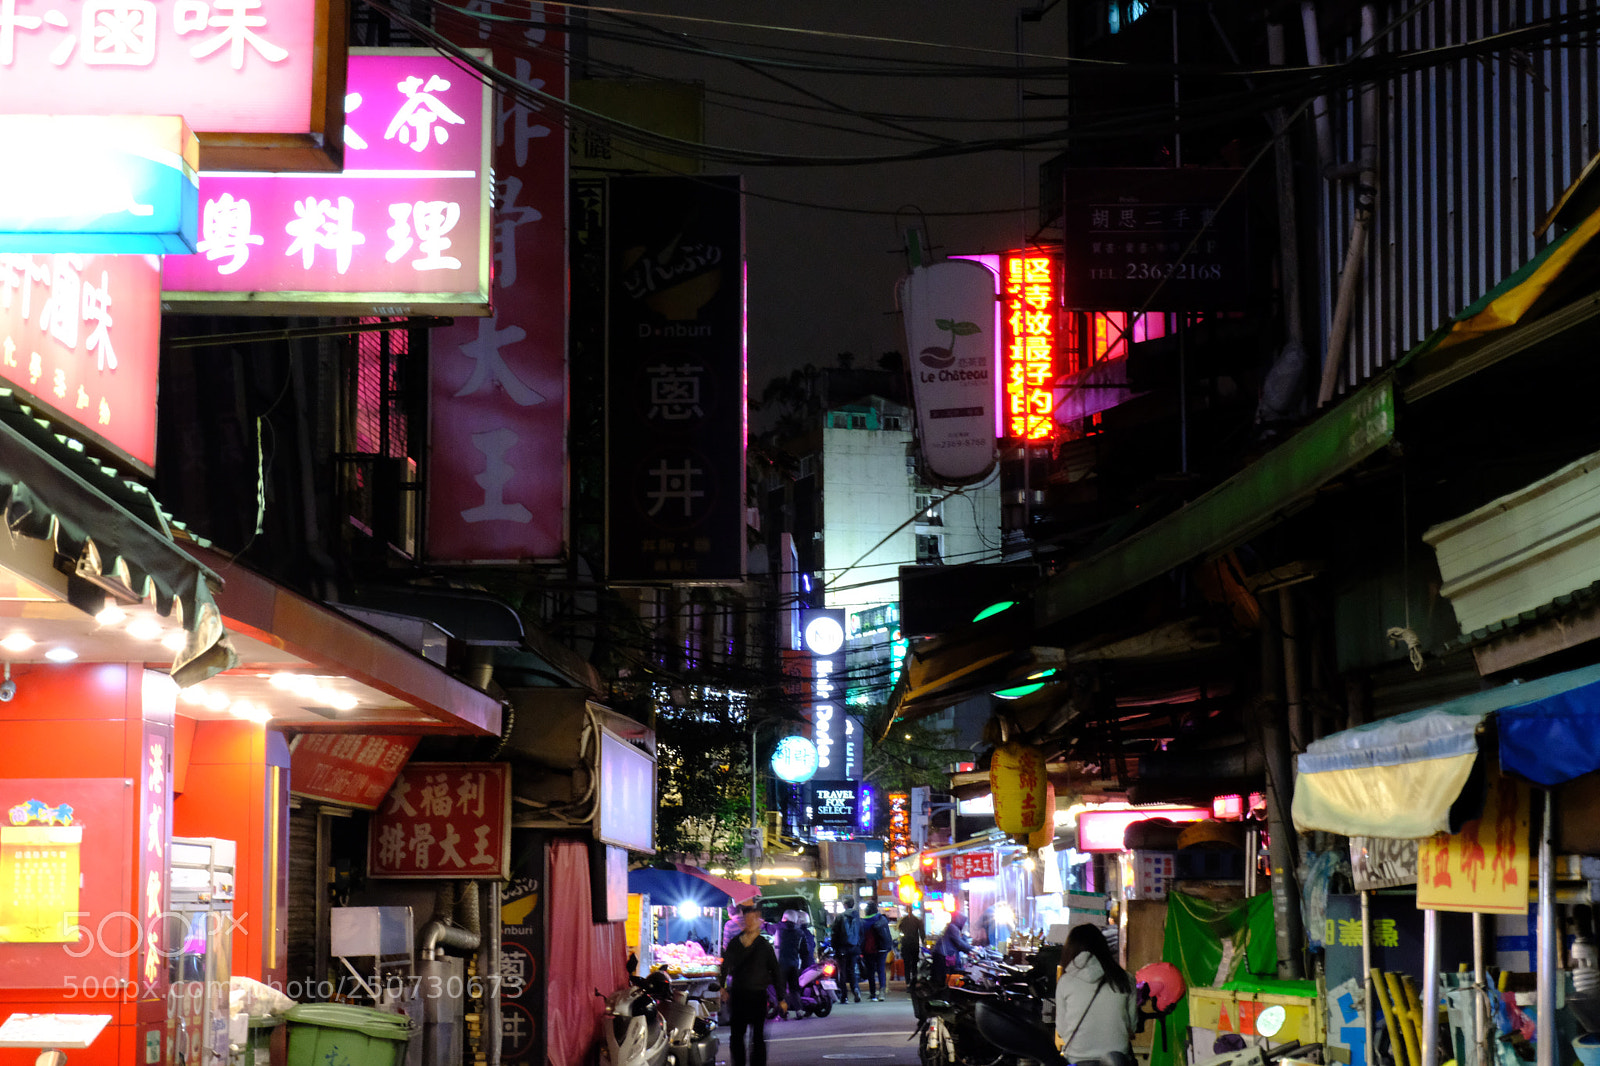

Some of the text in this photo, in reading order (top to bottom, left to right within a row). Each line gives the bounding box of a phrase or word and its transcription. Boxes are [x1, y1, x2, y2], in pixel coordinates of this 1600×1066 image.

[920, 369, 989, 383] Le Château
[816, 790, 855, 799] TRAVEL
[825, 798, 846, 807] FOX
[817, 806, 853, 815] SELECT
[378, 822, 495, 869] 排骨大王
